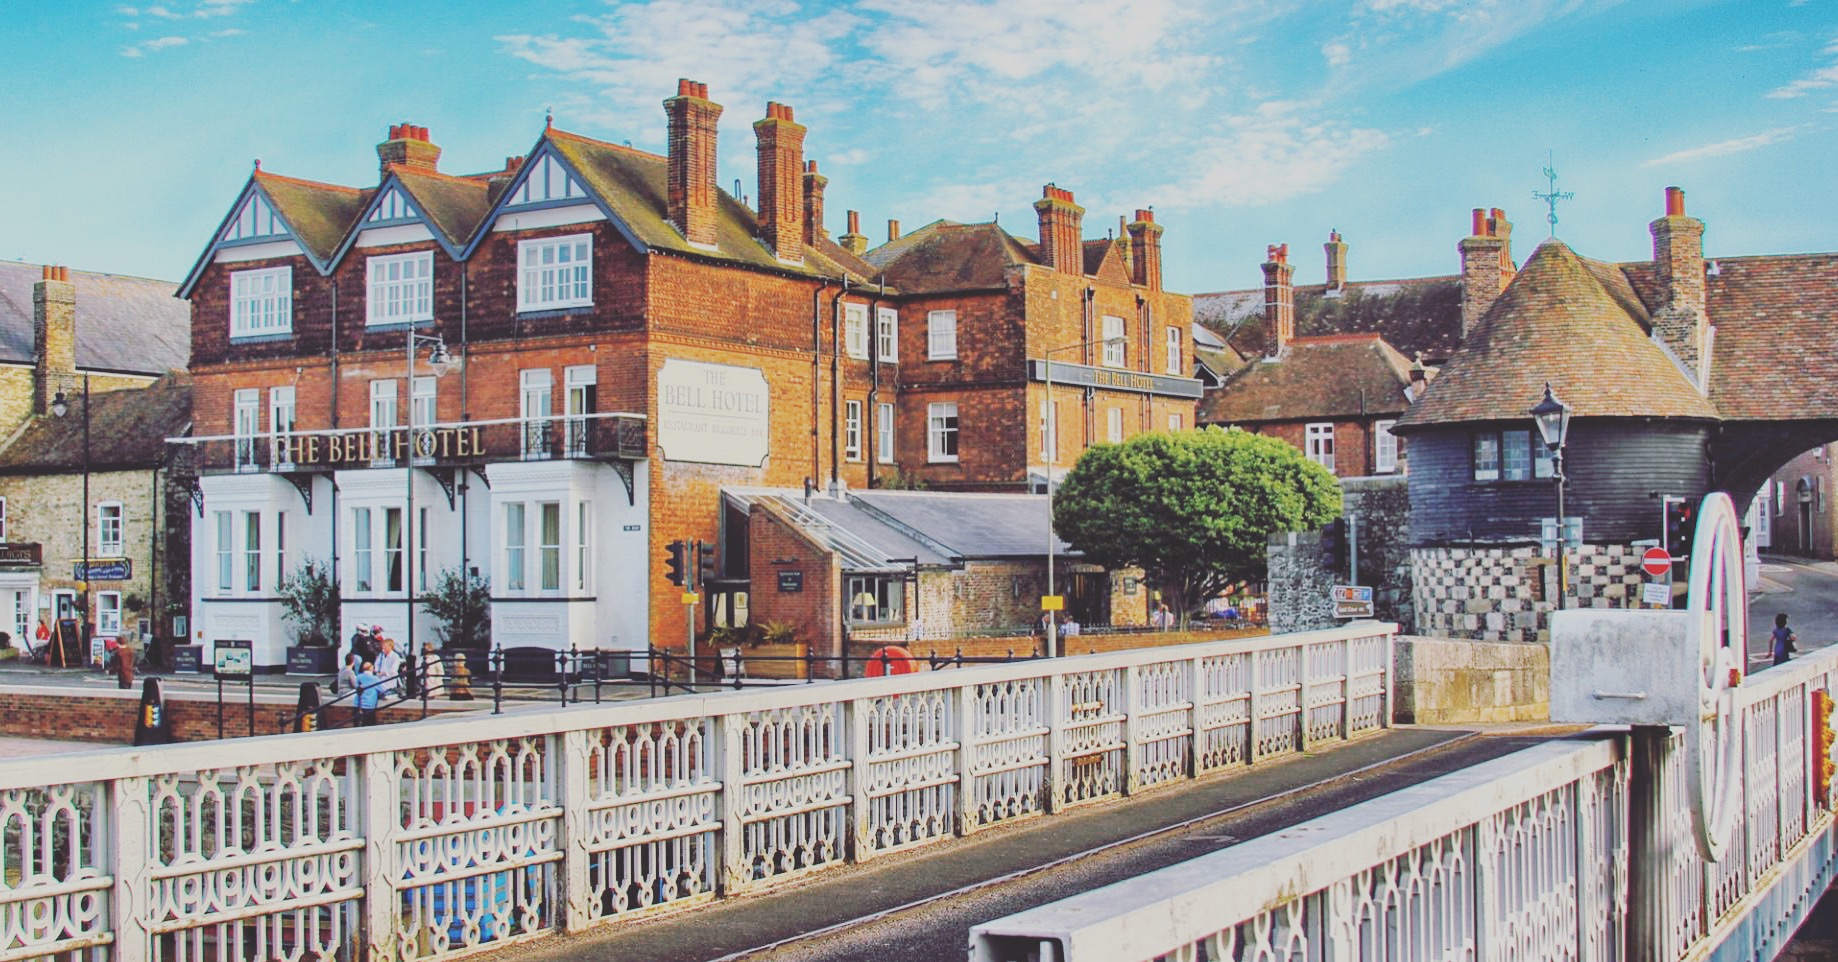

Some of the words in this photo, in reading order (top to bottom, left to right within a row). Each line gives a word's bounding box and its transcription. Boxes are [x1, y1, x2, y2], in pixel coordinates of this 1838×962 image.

[703, 369, 726, 385] THE
[1094, 370, 1109, 384] THE
[1112, 372, 1128, 387] BELL
[1130, 374, 1154, 389] HOTEL
[665, 384, 706, 408] BELL
[712, 389, 764, 414] HOTEL
[274, 435, 320, 464] THE
[328, 431, 384, 462] BELL
[395, 427, 486, 459] HOTEL
